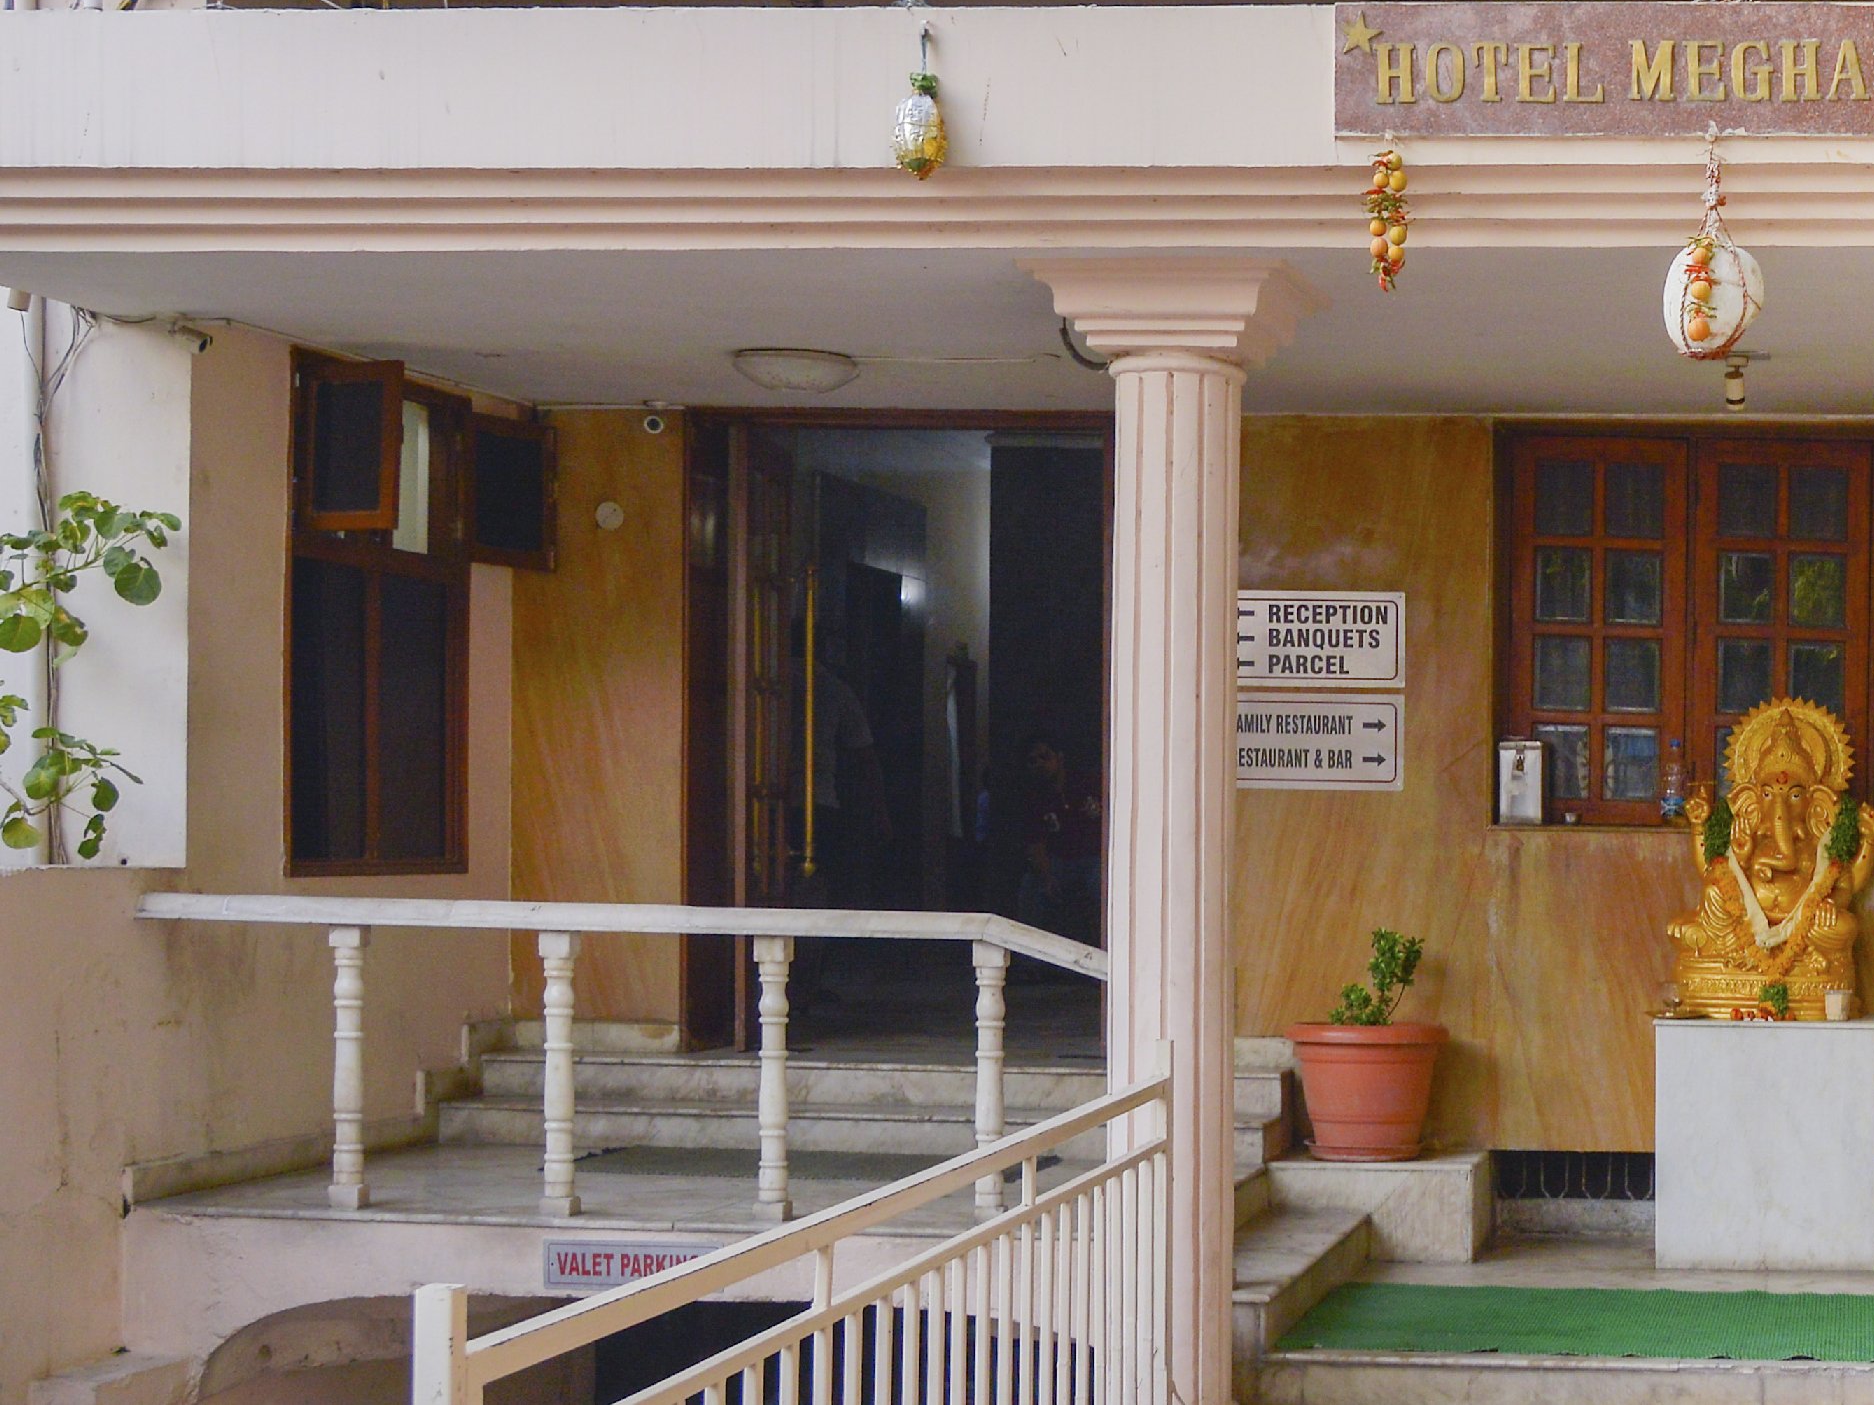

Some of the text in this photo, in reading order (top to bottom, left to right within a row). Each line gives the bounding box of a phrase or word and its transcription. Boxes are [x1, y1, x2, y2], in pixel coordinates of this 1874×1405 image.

[1375, 41, 1605, 105] HOTEL
[1629, 38, 1871, 103] MEGHA
[1268, 604, 1389, 625] RECEPTION
[1268, 628, 1380, 650] BANQUETS
[1268, 654, 1350, 675] PARCEL
[1237, 713, 1354, 735] AMILY RESTAURANT
[1238, 747, 1353, 769] ESTAURANT & BAR
[557, 1252, 615, 1277] VALET
